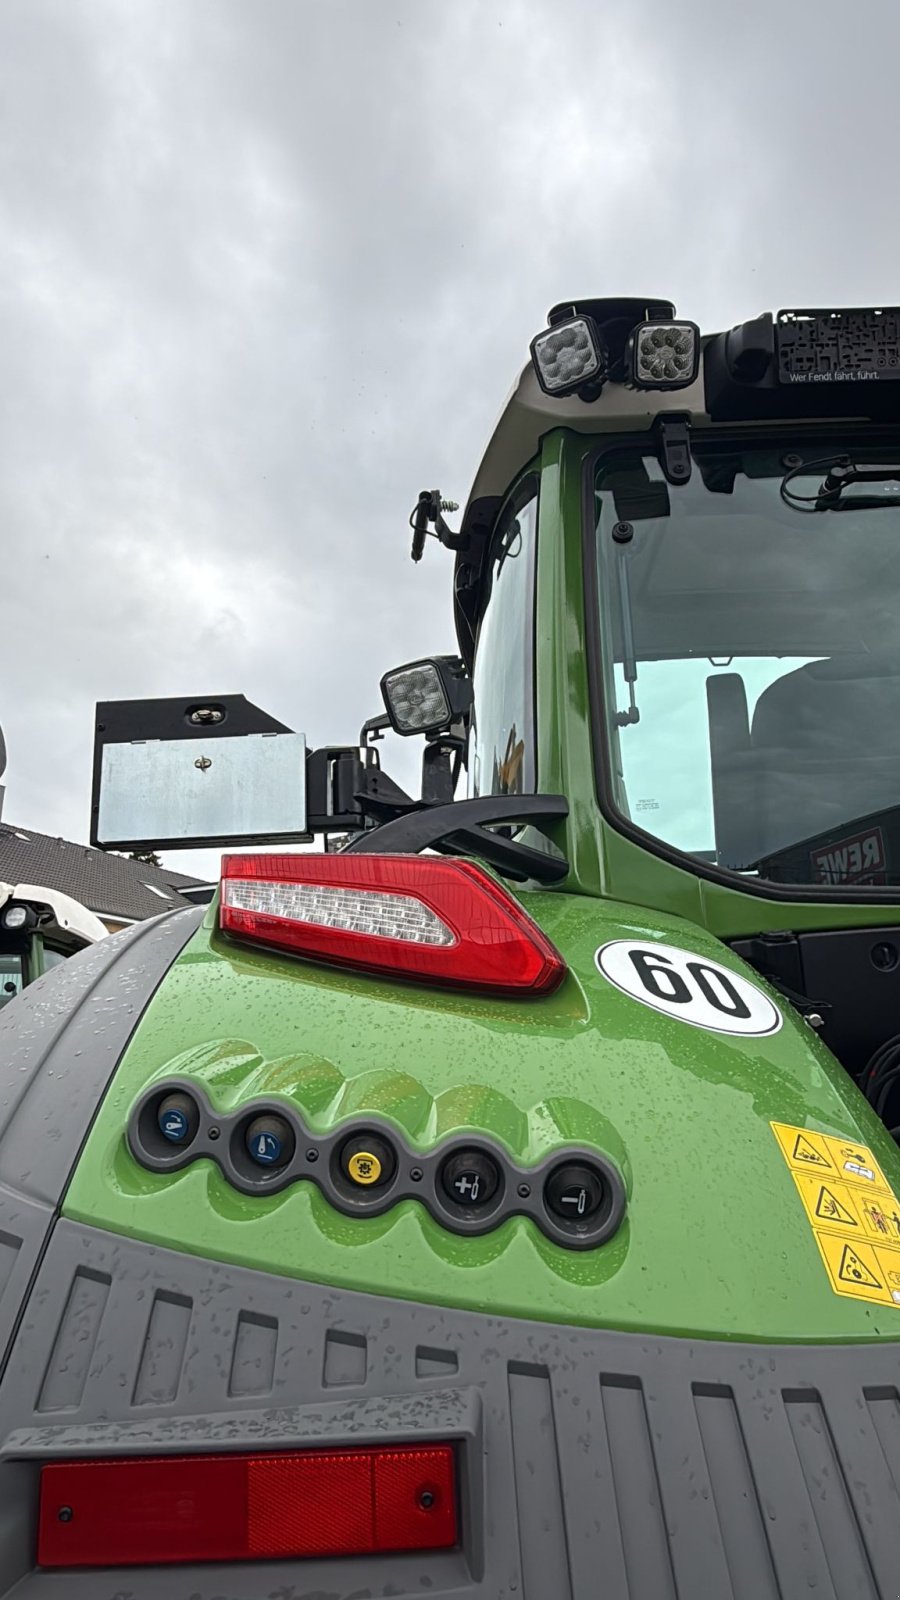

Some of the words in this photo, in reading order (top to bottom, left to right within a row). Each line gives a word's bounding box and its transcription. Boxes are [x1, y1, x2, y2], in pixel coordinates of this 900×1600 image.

[789, 373, 806, 381] Wer
[808, 372, 832, 381] Fendt
[834, 371, 856, 381] fährt,
[857, 370, 880, 380] führt.
[628, 949, 752, 1019] 60
